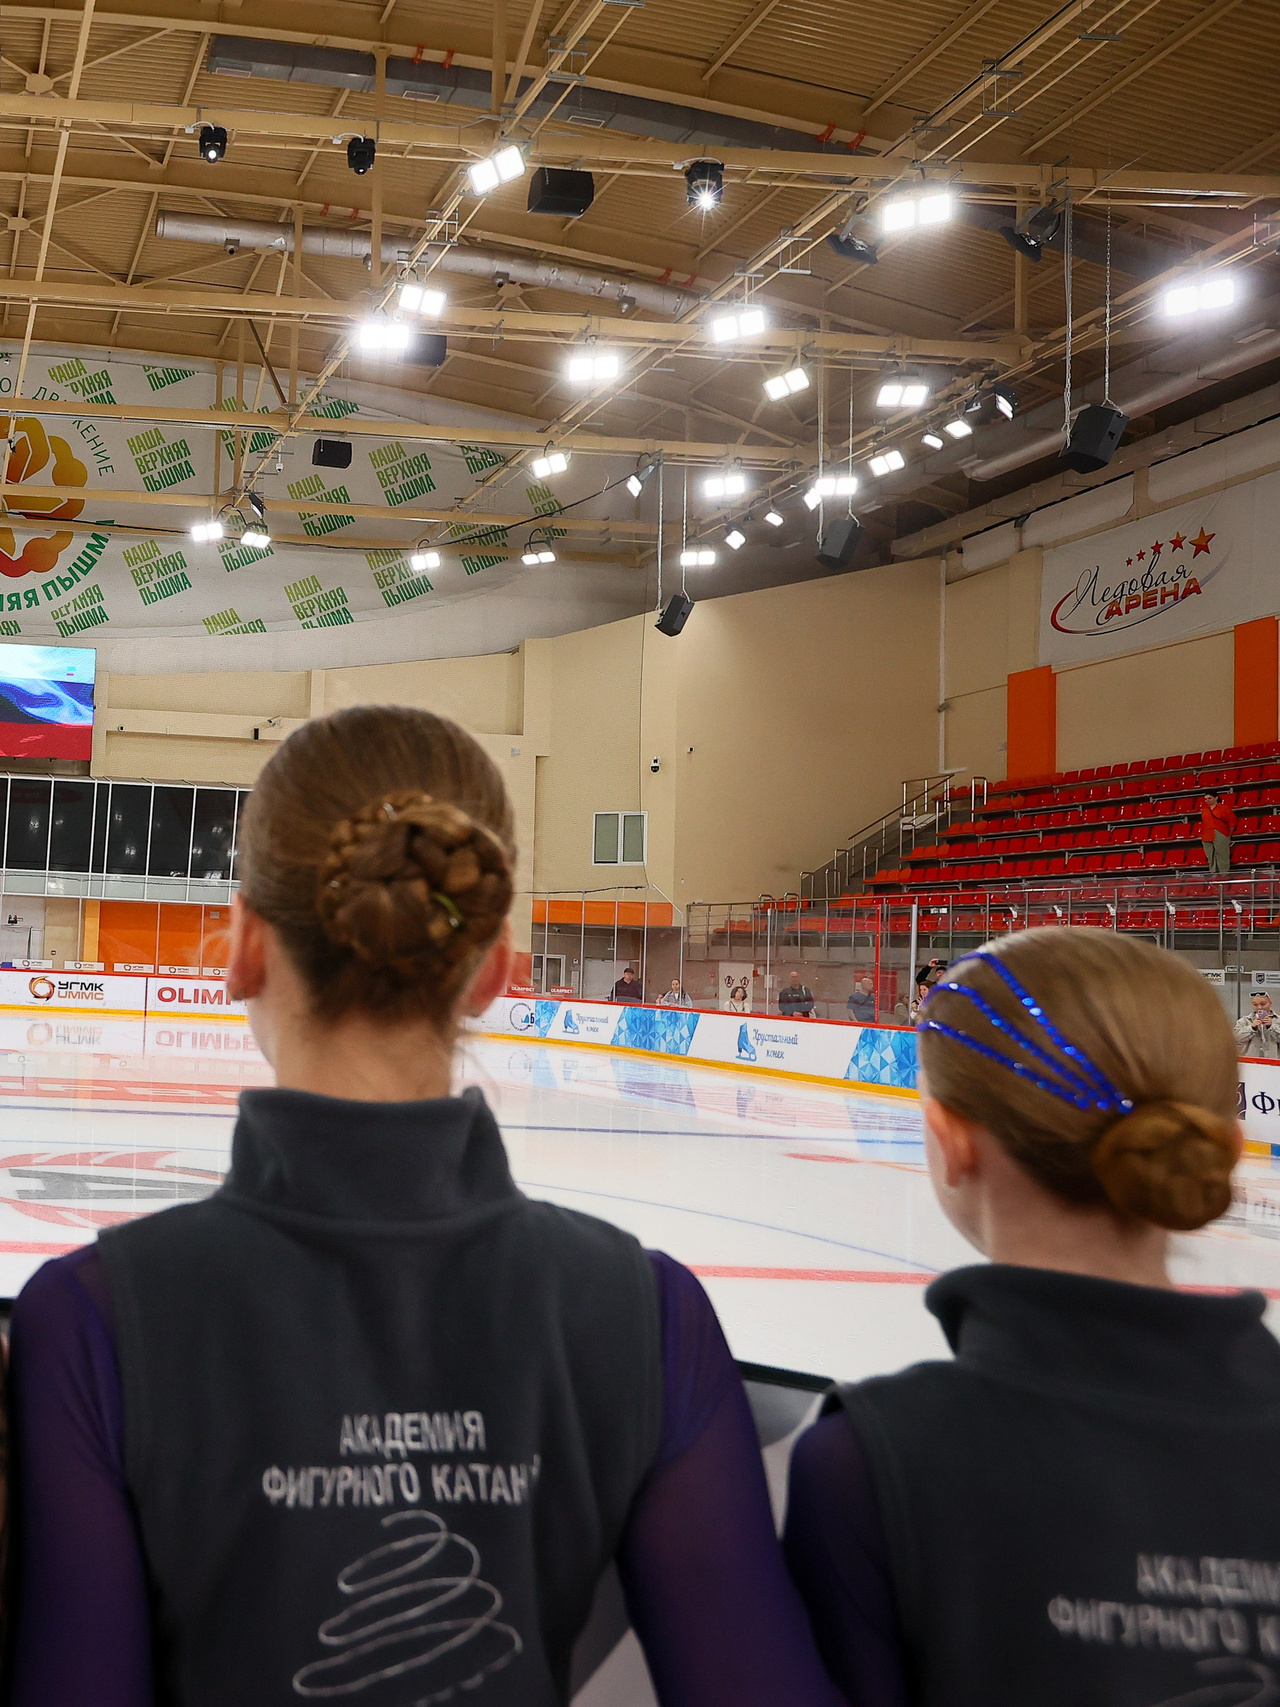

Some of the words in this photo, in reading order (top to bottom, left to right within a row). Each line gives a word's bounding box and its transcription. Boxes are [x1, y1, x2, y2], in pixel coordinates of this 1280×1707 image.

[126, 427, 166, 456] НАША
[134, 438, 192, 475] ВЕРХНЯЯ
[368, 442, 407, 469] НАША
[142, 460, 196, 492] ПЫШМА
[286, 474, 325, 500] НАША
[376, 453, 432, 489] ВЕРХНЯЯ
[384, 474, 436, 507] ПЫШМА
[122, 539, 161, 568] НАША
[130, 551, 187, 587] ВЕРХНЯЯ
[138, 572, 192, 606] ПЫШМА
[283, 575, 322, 603] НАША
[292, 586, 348, 621] ВЕРХНЯЯ
[381, 574, 434, 608] ПЫШМА
[1060, 553, 1192, 626] Ледовая
[1105, 577, 1202, 620] АРЕНА
[56, 605, 110, 638] ПЫШМА
[202, 608, 241, 635] НАША
[58, 980, 104, 992] УГМК
[58, 991, 104, 1000] UMMC
[753, 1028, 799, 1047] Хрустальный
[339, 1410, 486, 1461] АКАДЕМИЯ
[262, 1462, 420, 1509] ФИГУРНОГО
